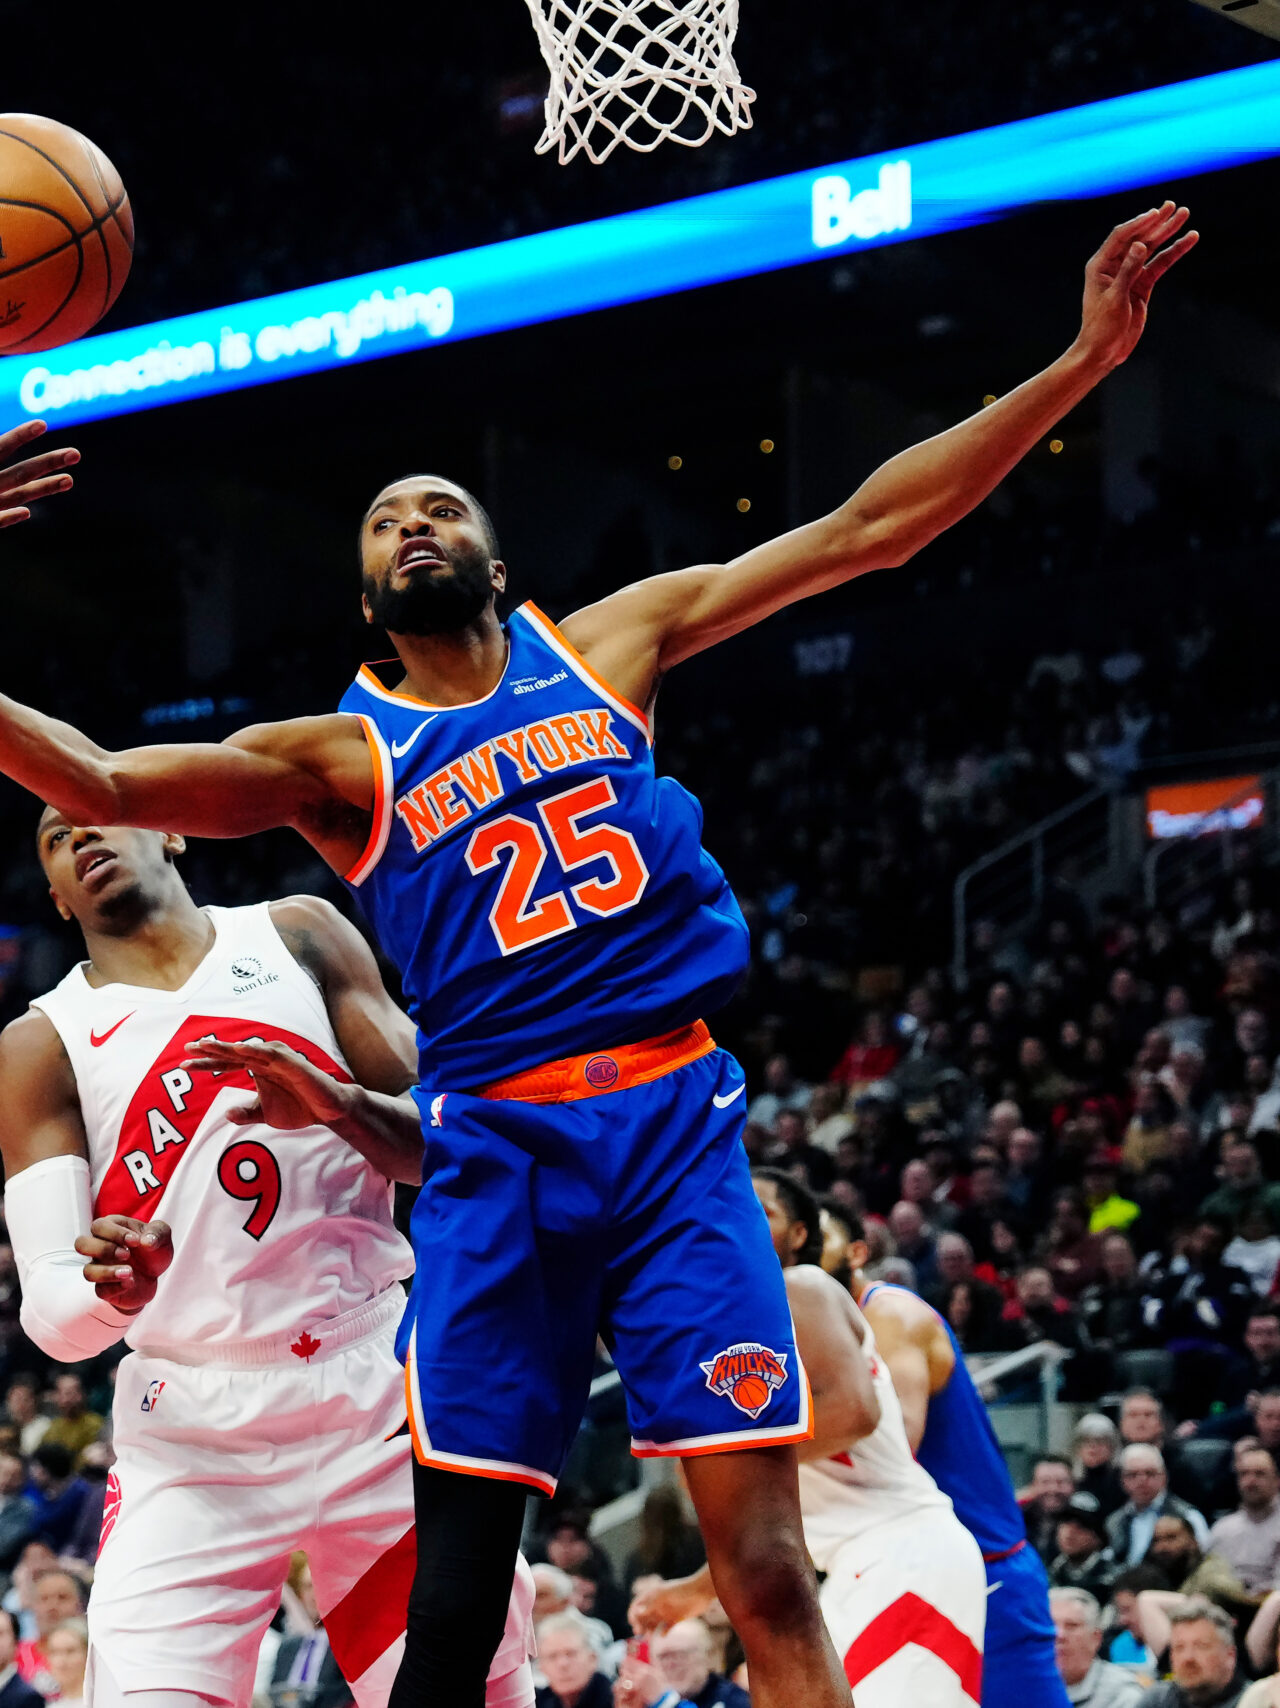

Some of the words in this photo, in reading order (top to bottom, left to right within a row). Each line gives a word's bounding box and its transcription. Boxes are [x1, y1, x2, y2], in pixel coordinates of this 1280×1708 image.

[811, 160, 911, 248] Bell
[20, 340, 215, 413] Connection
[219, 326, 252, 370] is
[255, 286, 454, 358] everything
[513, 684, 535, 695] abu
[534, 669, 568, 689] dhabi
[394, 738, 505, 853] NEW
[491, 708, 632, 785] YORK
[464, 774, 650, 957] 25
[232, 982, 257, 996] Sun
[257, 972, 280, 986] Life
[217, 1140, 281, 1241] 9
[710, 1350, 785, 1387] KNICKS
